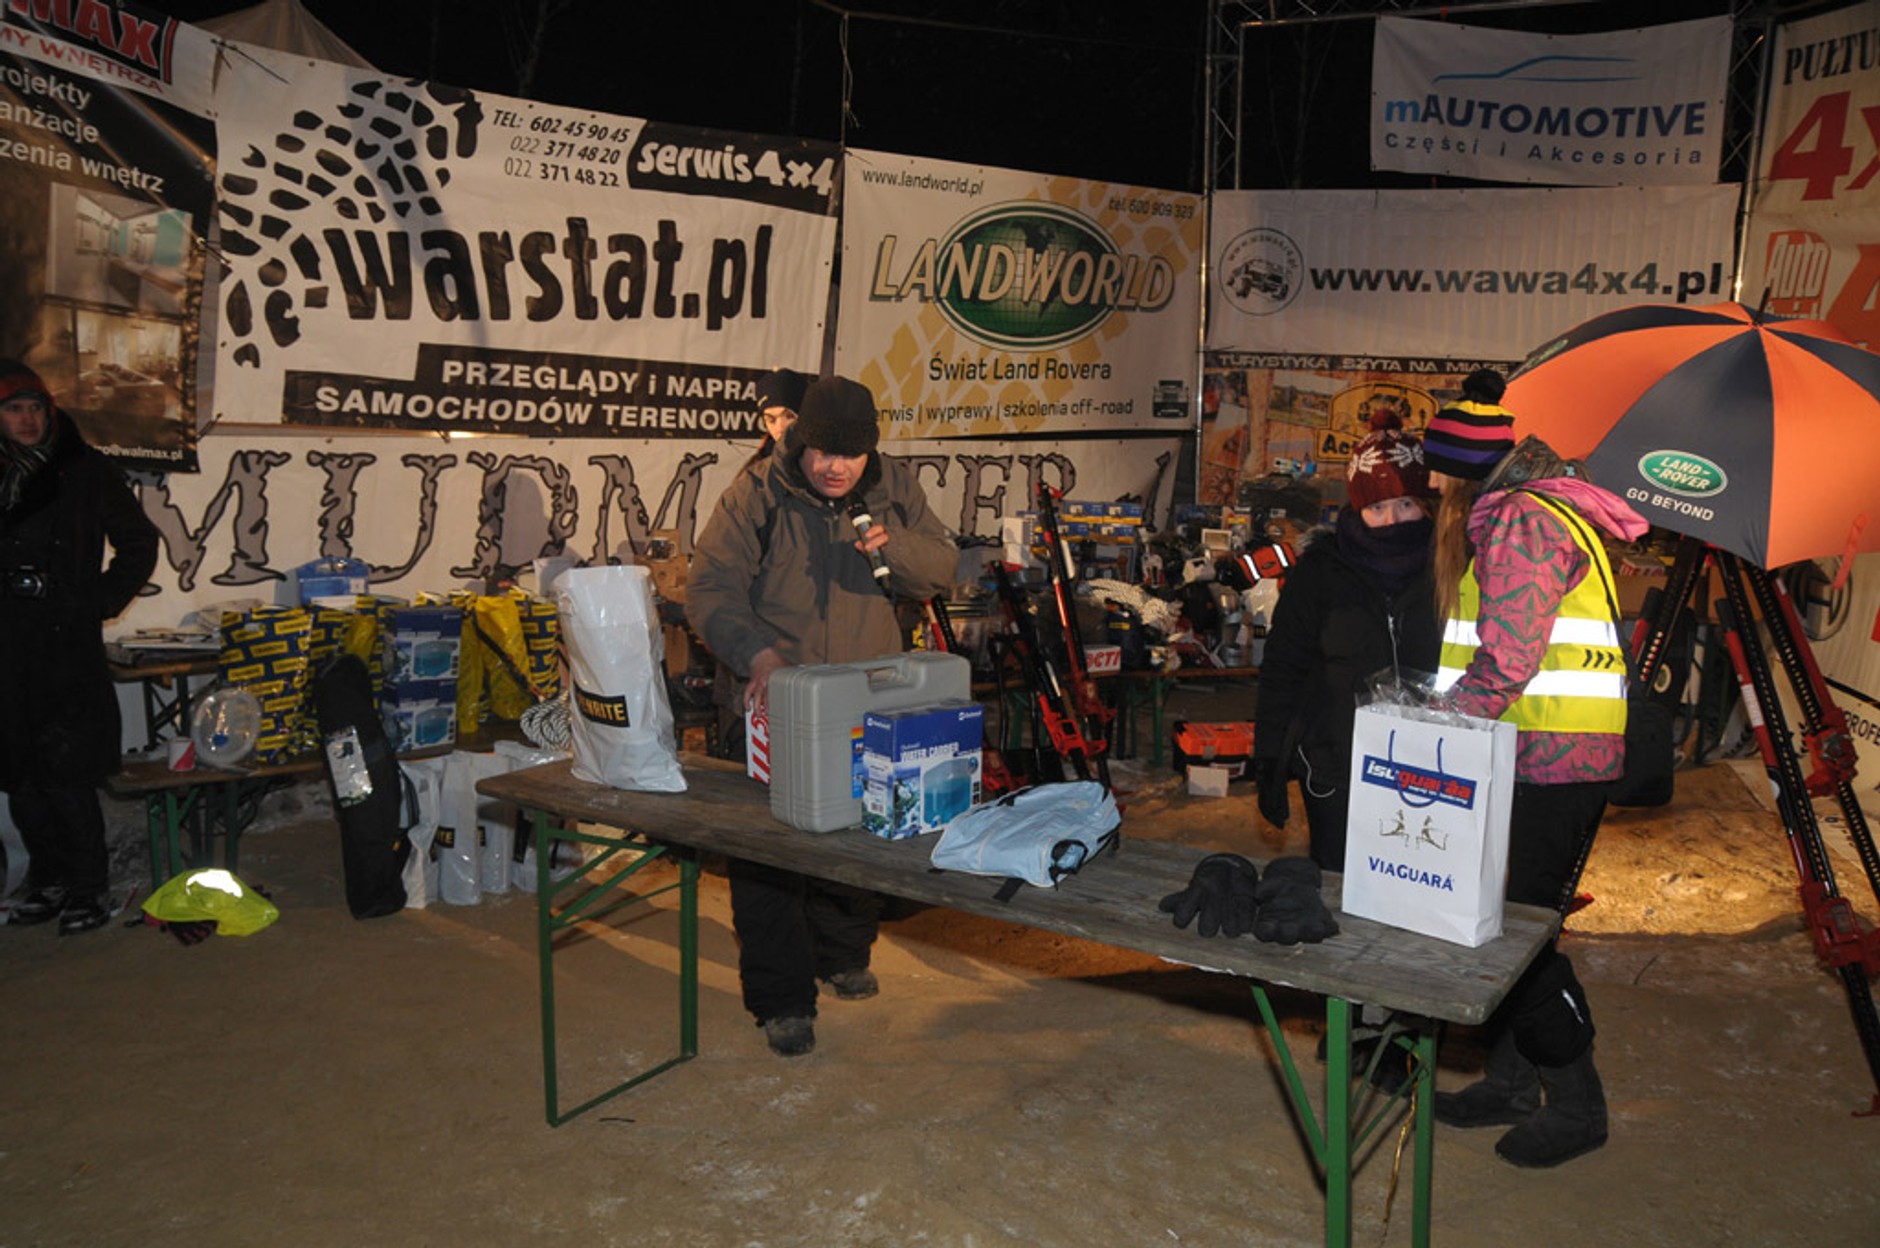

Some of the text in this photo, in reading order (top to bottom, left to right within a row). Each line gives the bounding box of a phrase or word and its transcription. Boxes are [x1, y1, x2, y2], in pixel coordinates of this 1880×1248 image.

[493, 109, 631, 143] TEL: 602 45 90 45
[1385, 94, 1705, 138] mAUTOMOTIVE
[510, 135, 621, 165] 022 371 48 20
[1527, 145, 1702, 166] Akcesoria
[81, 156, 163, 193] wnętrz
[504, 156, 620, 188] 022 371 48 22
[862, 168, 985, 198] www.landworld.pl
[1309, 262, 1724, 303] www.wawa4x4.pl
[441, 360, 639, 397] PRZEGLĄDY
[929, 352, 1111, 381] Świat Land Rovera
[1409, 358, 1438, 372] NA
[315, 386, 592, 426] SAMOCHODÓW
[925, 404, 993, 422] wyprawy
[1003, 399, 1068, 416] szkolenia
[1070, 398, 1133, 415] off-road
[1626, 487, 1715, 521] GO BEYOND
[1368, 855, 1455, 892] VIAGUARÁ
